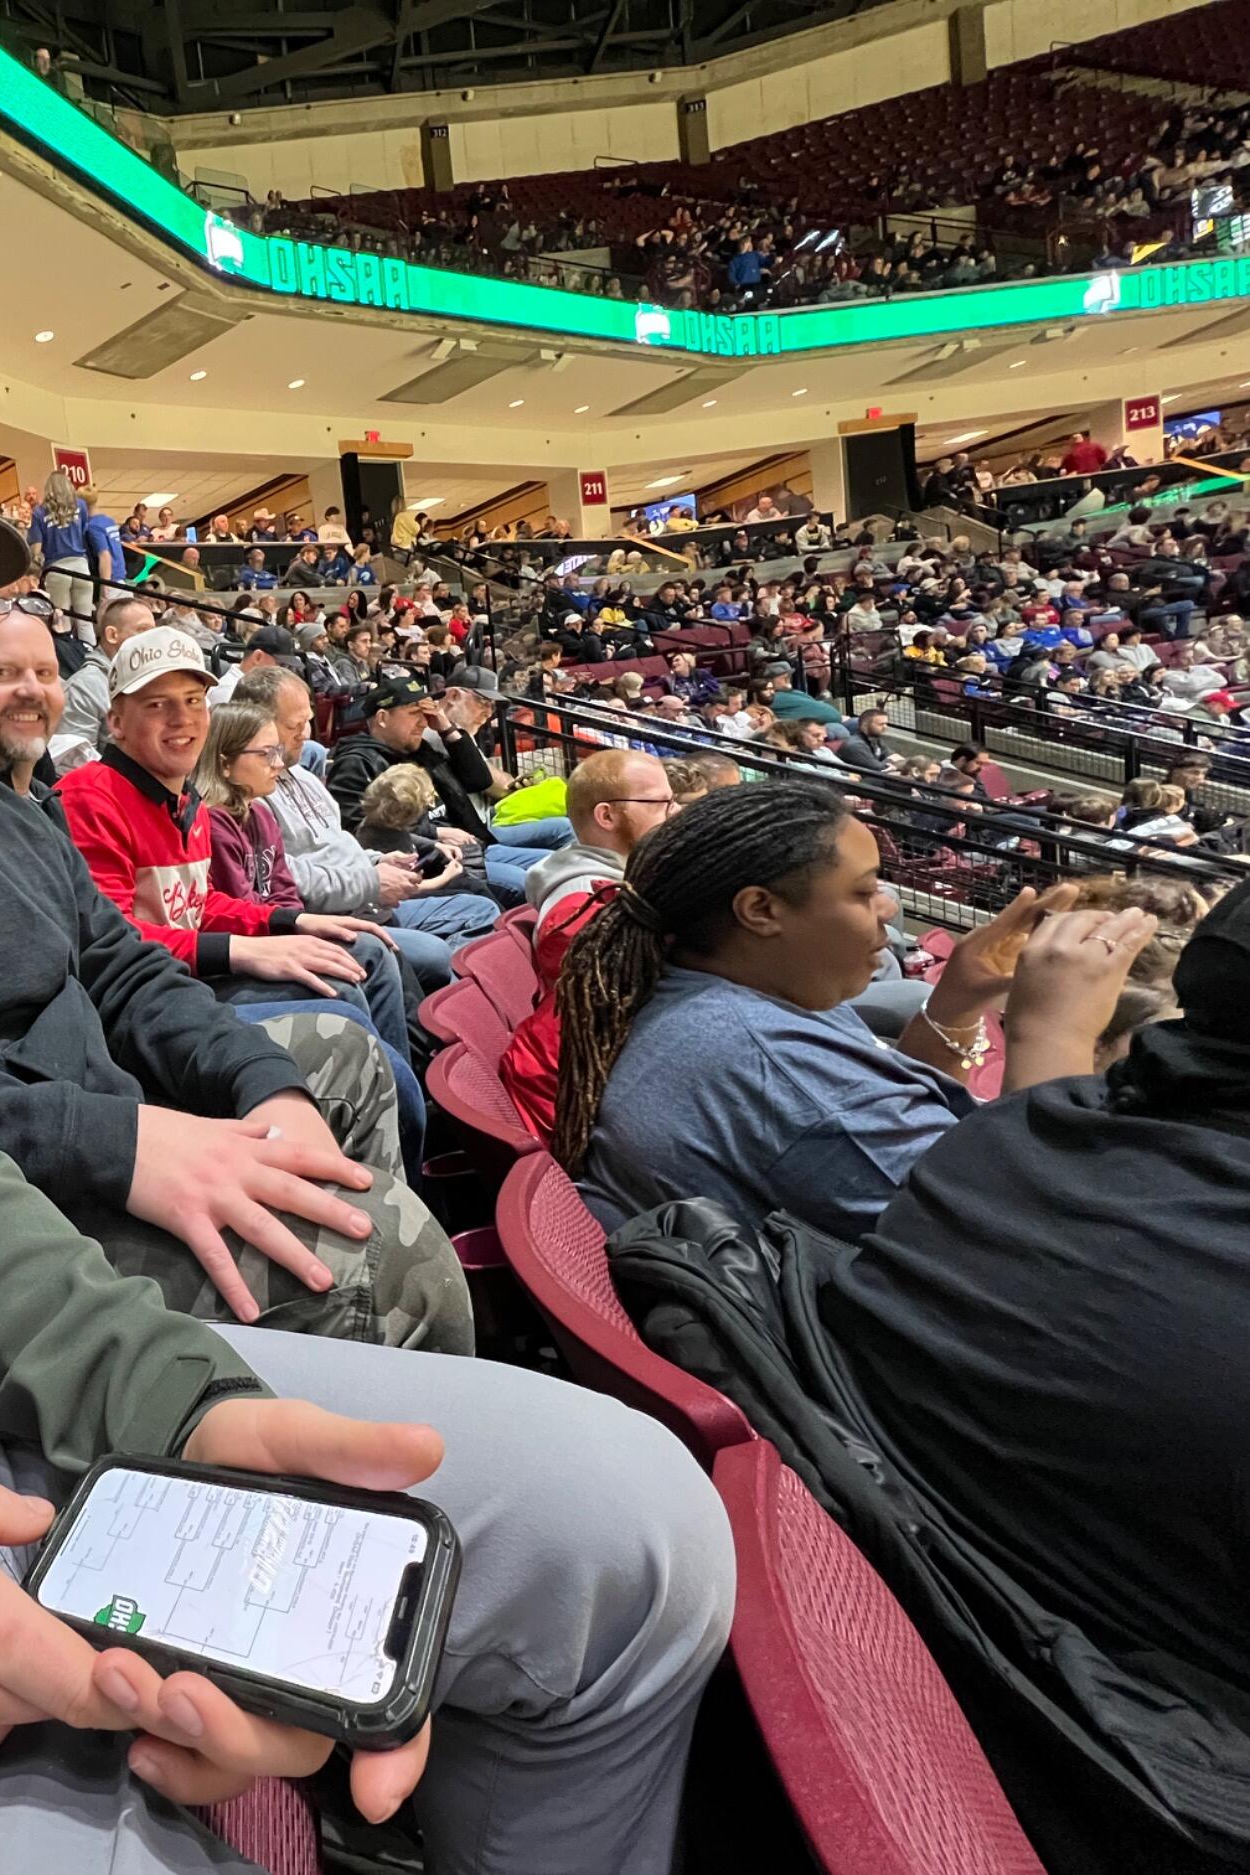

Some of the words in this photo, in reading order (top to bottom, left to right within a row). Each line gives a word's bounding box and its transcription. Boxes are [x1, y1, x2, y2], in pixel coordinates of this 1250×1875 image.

[269, 236, 410, 310] OHSAA
[684, 309, 781, 355] OHSAA
[1130, 405, 1156, 421] 213
[61, 464, 86, 483] 210
[584, 482, 603, 495] 211
[129, 646, 162, 671] Ohio
